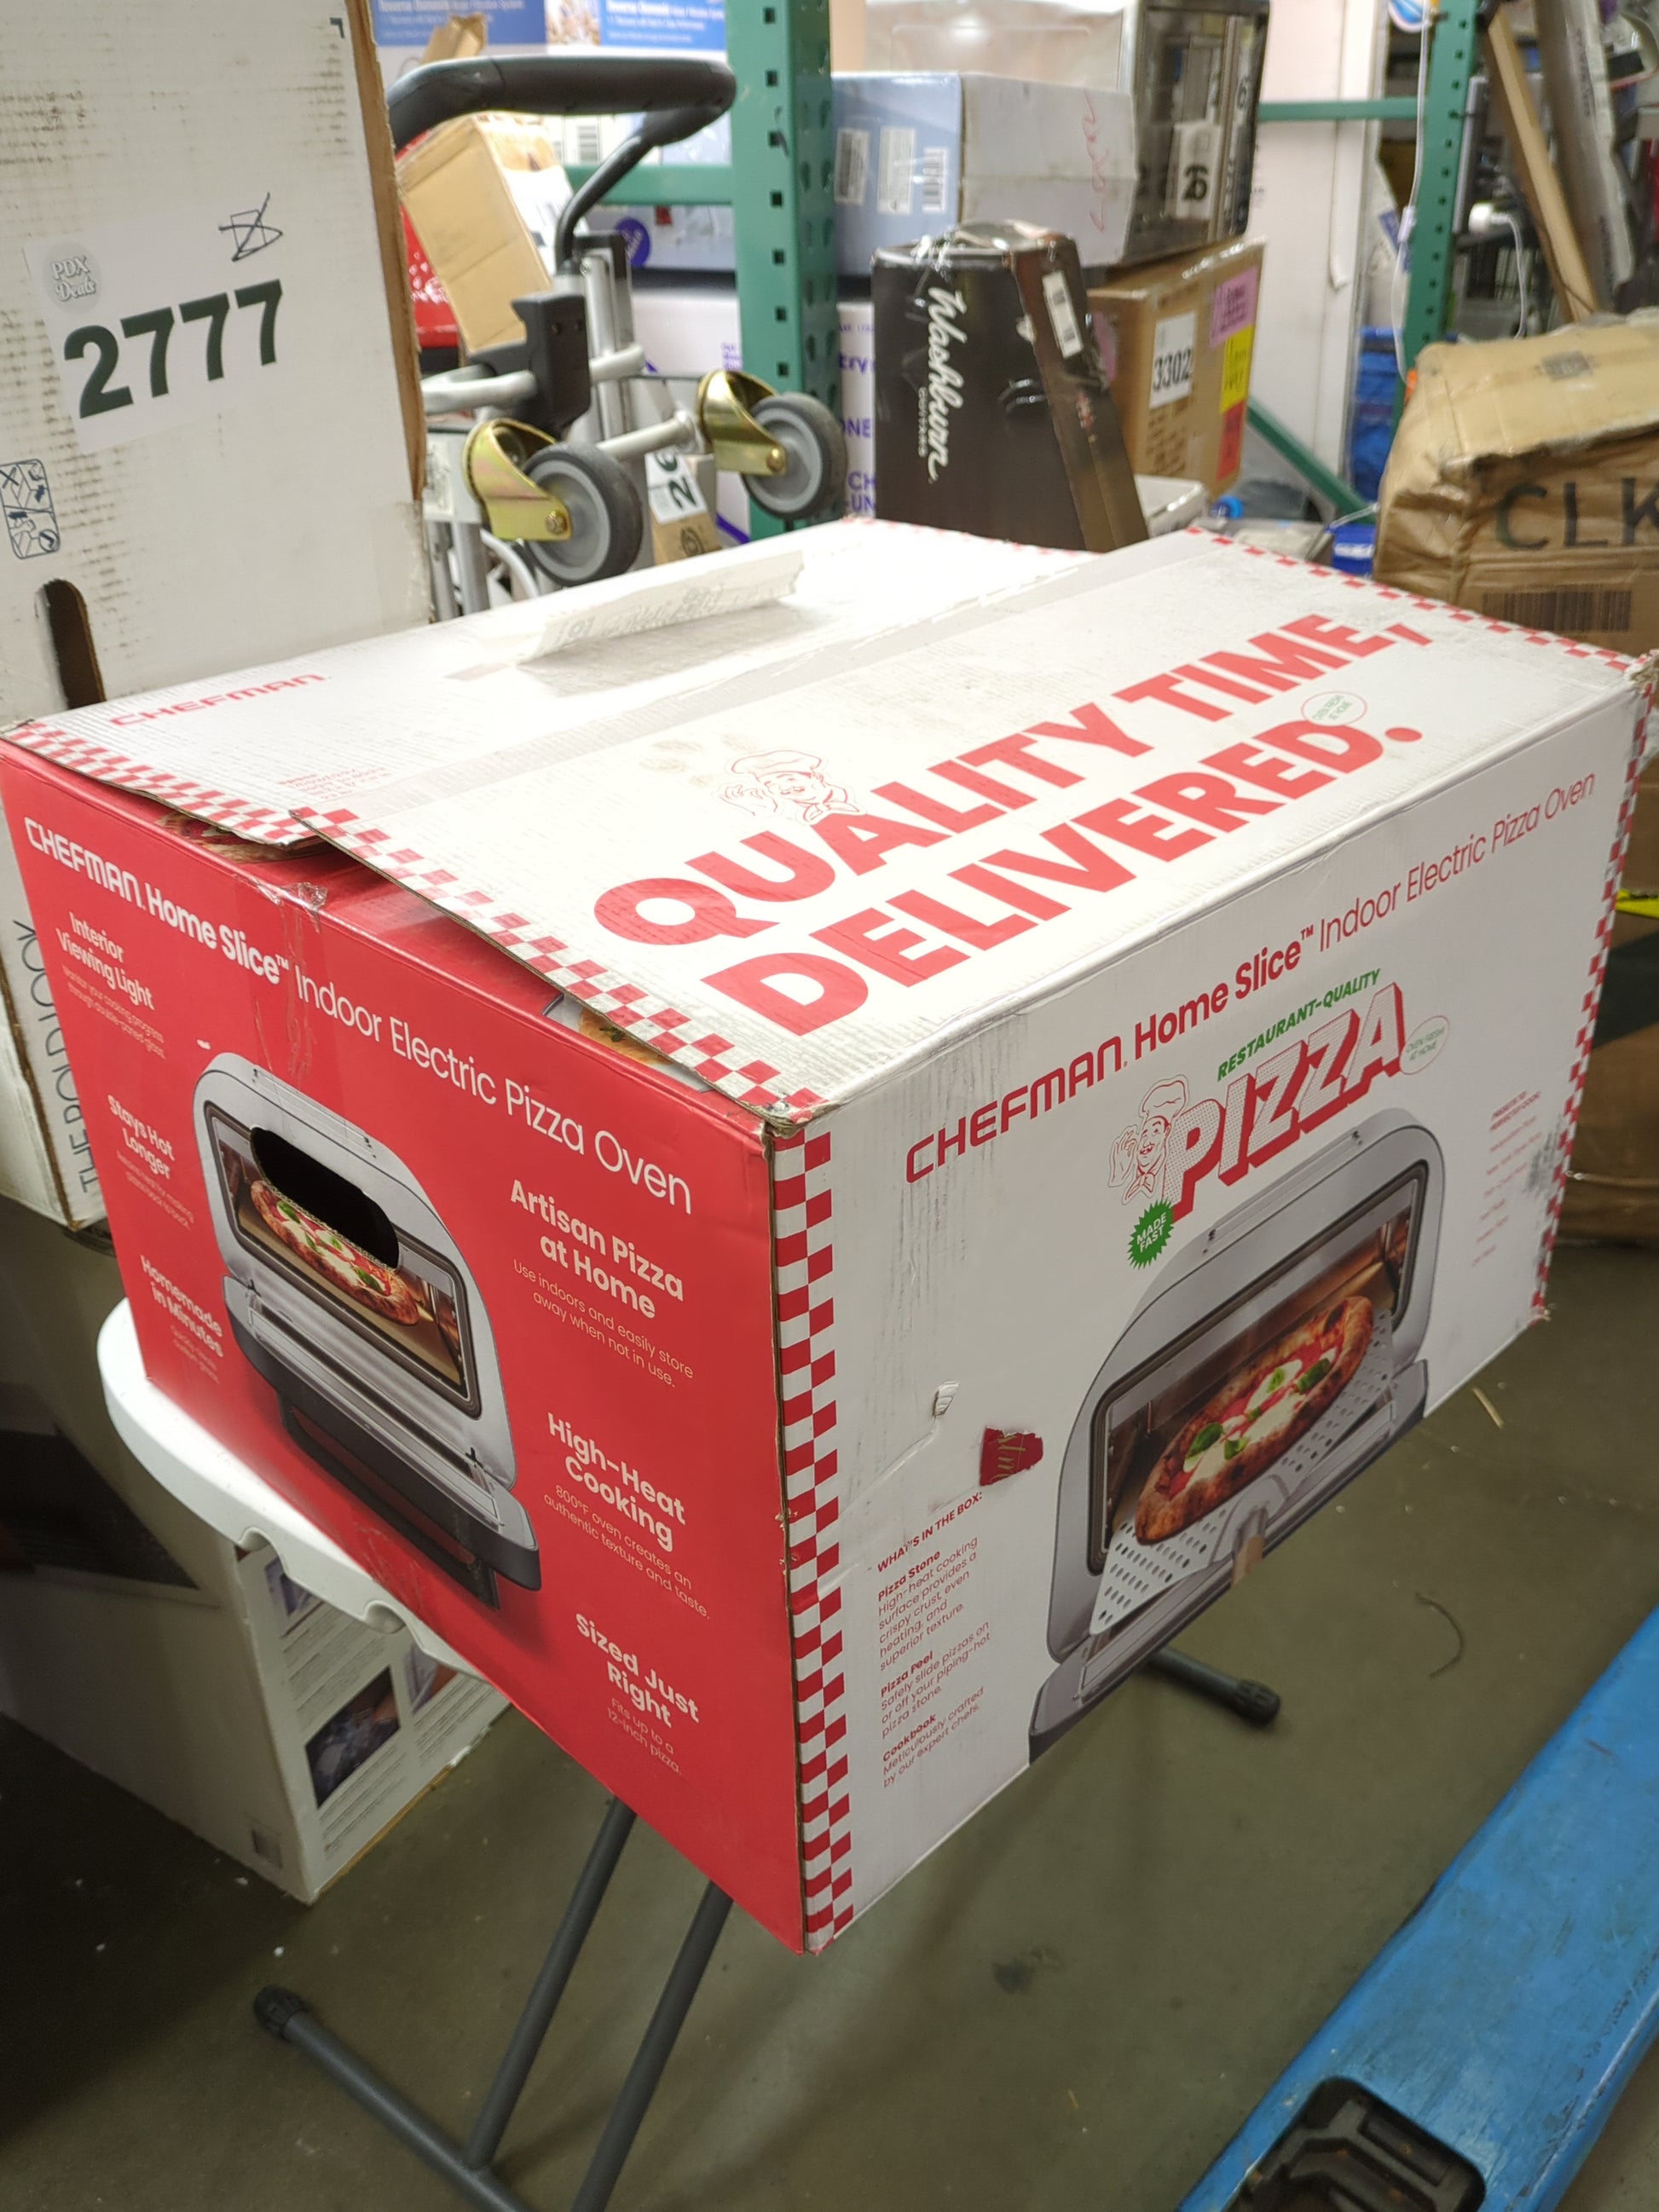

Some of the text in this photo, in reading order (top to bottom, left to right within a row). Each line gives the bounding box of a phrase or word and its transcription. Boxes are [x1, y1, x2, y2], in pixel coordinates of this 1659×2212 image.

[53, 255, 90, 280] PDX
[55, 274, 97, 302] Deals
[64, 279, 283, 419] 2777
[928, 287, 968, 482] Washburn
[1153, 349, 1192, 390] 3302
[1495, 476, 1659, 551] CLK
[109, 673, 327, 726] CHEFMAN
[593, 613, 1433, 945] QUALITY TIME,
[700, 719, 1423, 1037] DELIVERED.
[55, 927, 155, 1011] Viewing Light
[69, 911, 124, 963] Interior
[25, 817, 144, 910] CHEFMAN
[145, 882, 217, 949] Home
[295, 963, 382, 1042] Indoor
[390, 1017, 497, 1106] Electric
[505, 1077, 585, 1155] Pizza
[596, 1130, 692, 1215] Oven
[906, 1036, 1123, 1183] CHEFMAN
[1135, 983, 1228, 1060] Home
[1320, 882, 1401, 952] Indoor
[1407, 834, 1486, 903] Electric
[1491, 804, 1540, 853] Pizza
[1545, 772, 1595, 821] Oven
[1217, 968, 1381, 1083] RESTAURANT-QUALITY
[107, 1094, 176, 1162] Stays Hot
[1163, 982, 1406, 1224] PIZZA
[123, 1127, 171, 1180] Longer
[511, 1179, 684, 1302] Artisan Pizza
[1136, 1211, 1166, 1245] MADE
[1139, 1224, 1165, 1253] FAST
[150, 1280, 167, 1308] in
[540, 1236, 656, 1319] at Home
[513, 1258, 693, 1378] Use indoors and easily store
[533, 1291, 675, 1388] away when not in use.
[547, 1412, 686, 1525] High-Heat
[565, 1456, 673, 1552] Cooking
[592, 1513, 621, 1540] oven
[625, 1535, 671, 1574] creates
[674, 1572, 692, 1591] an
[922, 1526, 934, 1541] IN
[935, 1510, 955, 1530] THE
[957, 1492, 982, 1515] BOX:
[544, 1493, 709, 1620] authentic texture and taste.
[878, 1551, 940, 1602] Pizza Stone
[879, 1537, 978, 1616] High-heat cooking
[879, 1552, 977, 1630] surface provides a
[879, 1614, 911, 1644] crispy
[945, 1571, 969, 1594] even
[926, 1599, 947, 1621] and
[575, 1613, 699, 1724] Sized Just
[881, 1632, 923, 1671] superior
[881, 1650, 933, 1698] Pizza Peel
[882, 1621, 989, 1711] Safely slide pizzas on
[882, 1632, 991, 1724] or off your piping-hot
[607, 1660, 672, 1728] Right
[612, 1697, 674, 1755] Fits up to a
[882, 1710, 910, 1740] pizza
[883, 1686, 984, 1775] Meticulously crafted
[883, 1713, 936, 1762] Cookbook
[884, 1772, 896, 1788] by
[899, 1754, 915, 1775] our
[917, 1727, 949, 1758] expert
